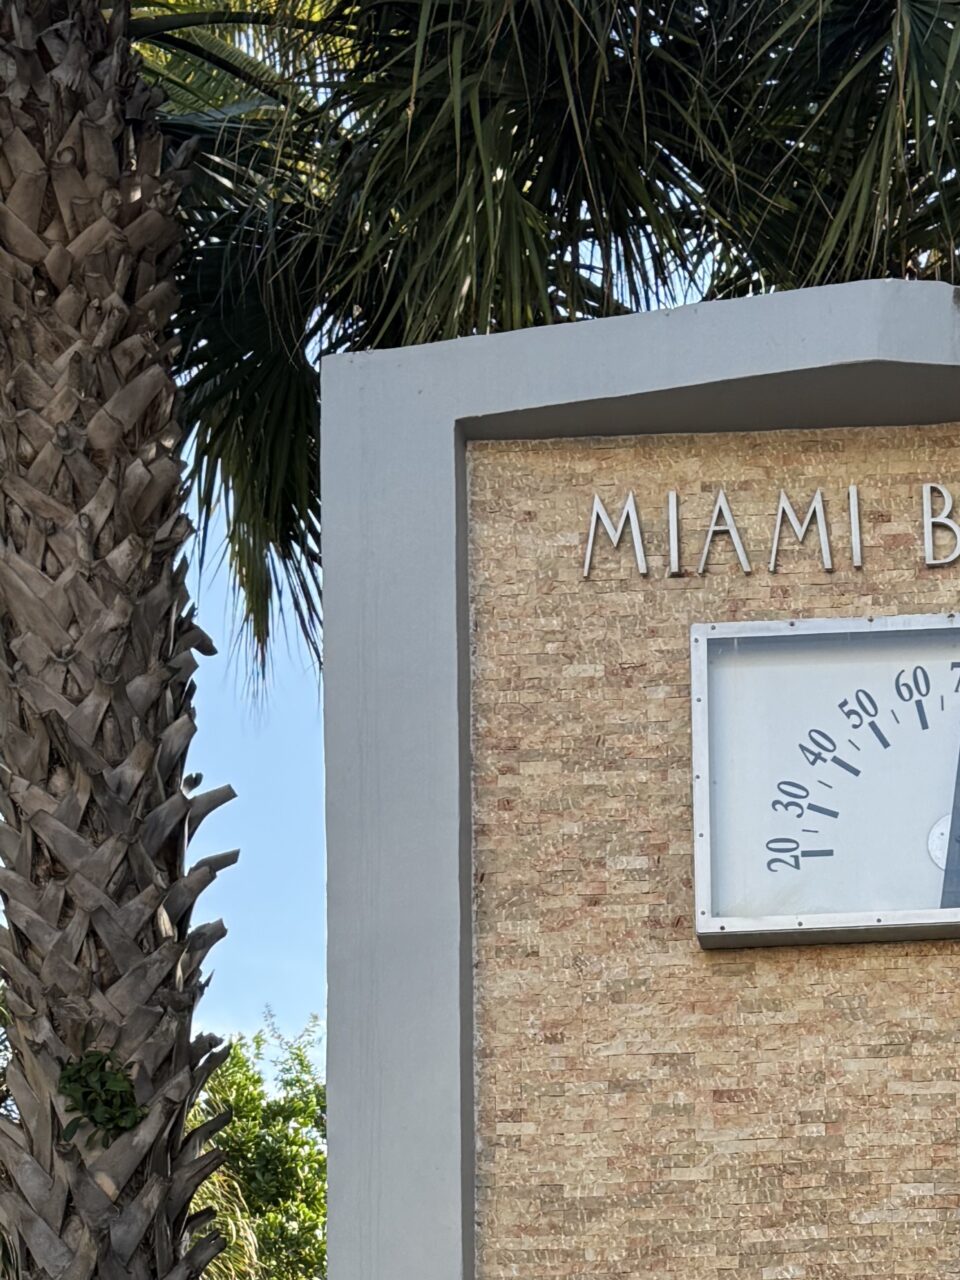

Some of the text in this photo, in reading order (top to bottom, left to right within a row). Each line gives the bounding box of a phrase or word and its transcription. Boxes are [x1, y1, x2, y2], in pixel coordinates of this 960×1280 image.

[583, 484, 863, 577] MIAMI
[894, 665, 931, 703] 60
[837, 688, 879, 730] 50
[798, 728, 837, 767] 40
[771, 780, 810, 819] 30
[765, 837, 801, 873] 20
